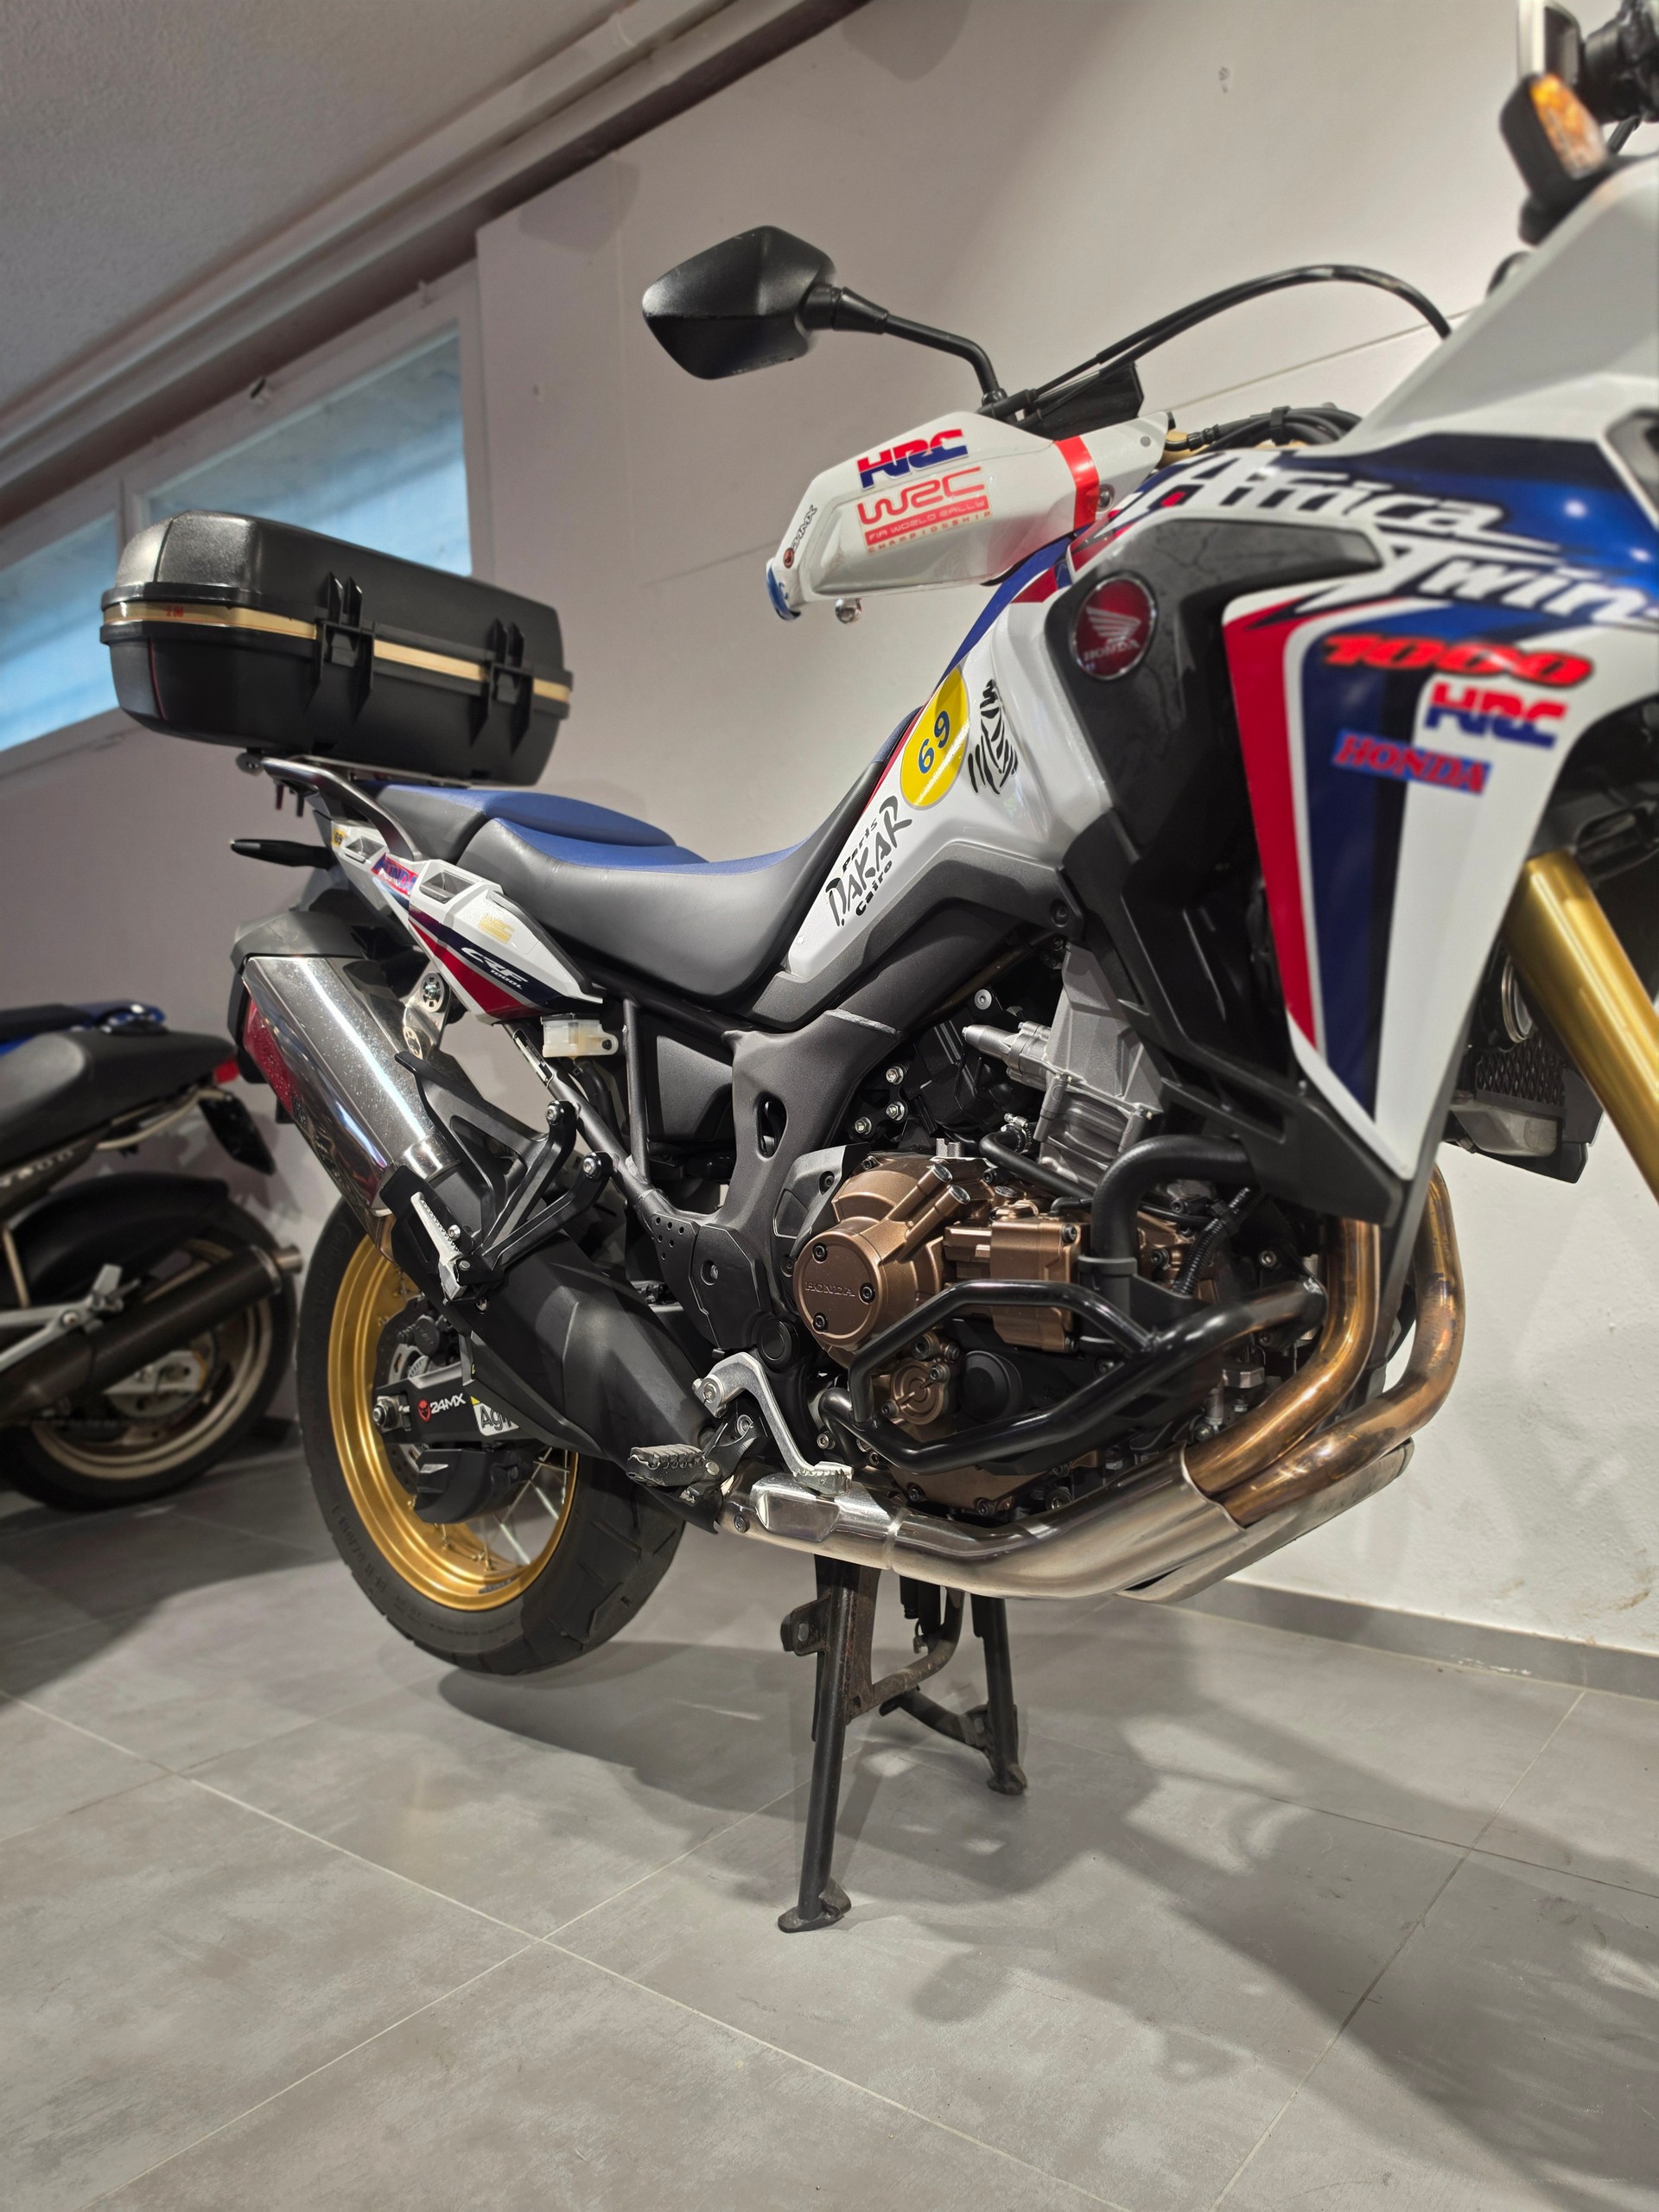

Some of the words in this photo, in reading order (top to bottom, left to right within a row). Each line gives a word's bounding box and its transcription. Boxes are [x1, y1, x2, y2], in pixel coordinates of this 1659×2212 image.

[857, 429, 969, 490] HRC
[857, 466, 985, 525] WRC
[868, 531, 888, 542] FIA
[890, 513, 938, 534] WORLD
[939, 499, 986, 518] RALLY
[868, 512, 992, 554] CHAMPIONSHIP
[1322, 632, 1595, 689] 1000
[918, 710, 950, 773] 69
[1424, 681, 1568, 750] HRC
[1332, 733, 1490, 794] HONDA
[824, 795, 912, 926] DAKAR
[461, 947, 529, 982] CRF
[804, 1281, 856, 1297] HONDA
[430, 1393, 466, 1414] 24MX
